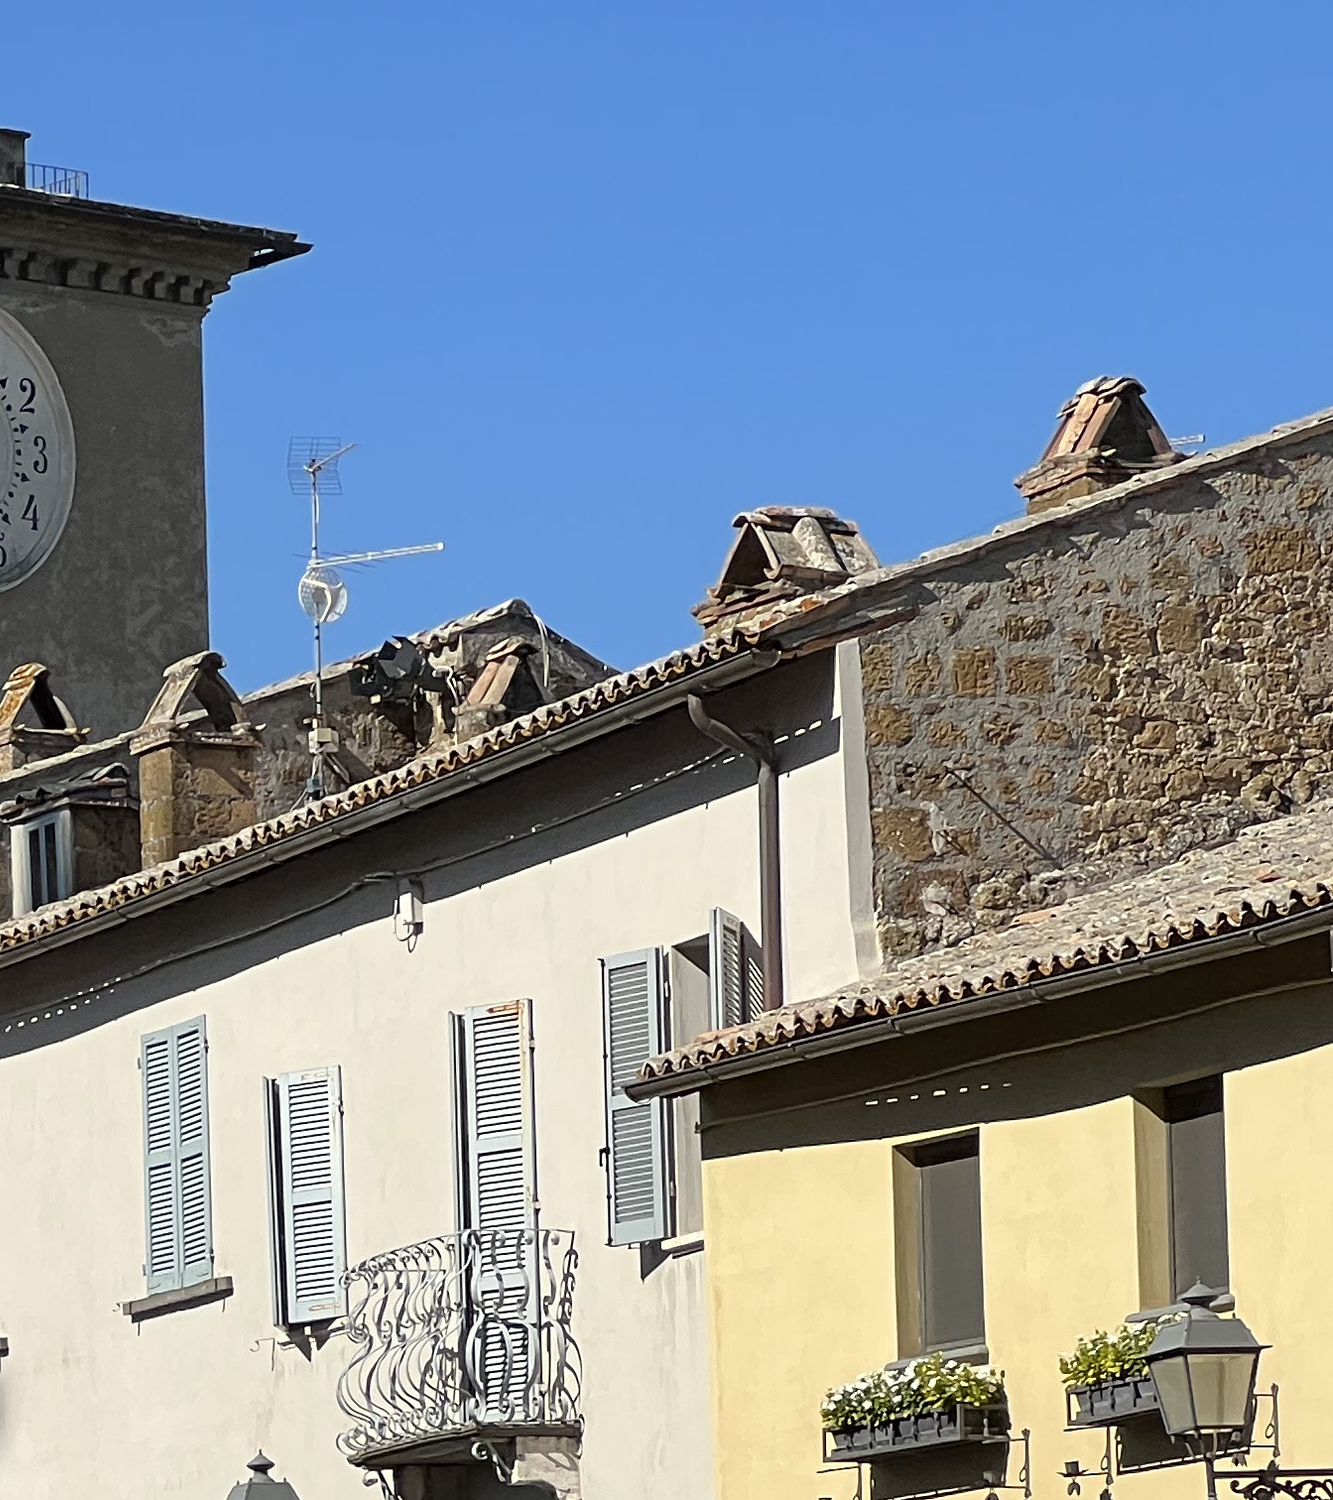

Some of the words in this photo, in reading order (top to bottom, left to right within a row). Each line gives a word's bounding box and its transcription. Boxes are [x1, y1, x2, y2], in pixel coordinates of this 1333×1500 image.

[19, 377, 36, 414] 2
[33, 435, 48, 474] 3
[21, 494, 40, 531] 4
